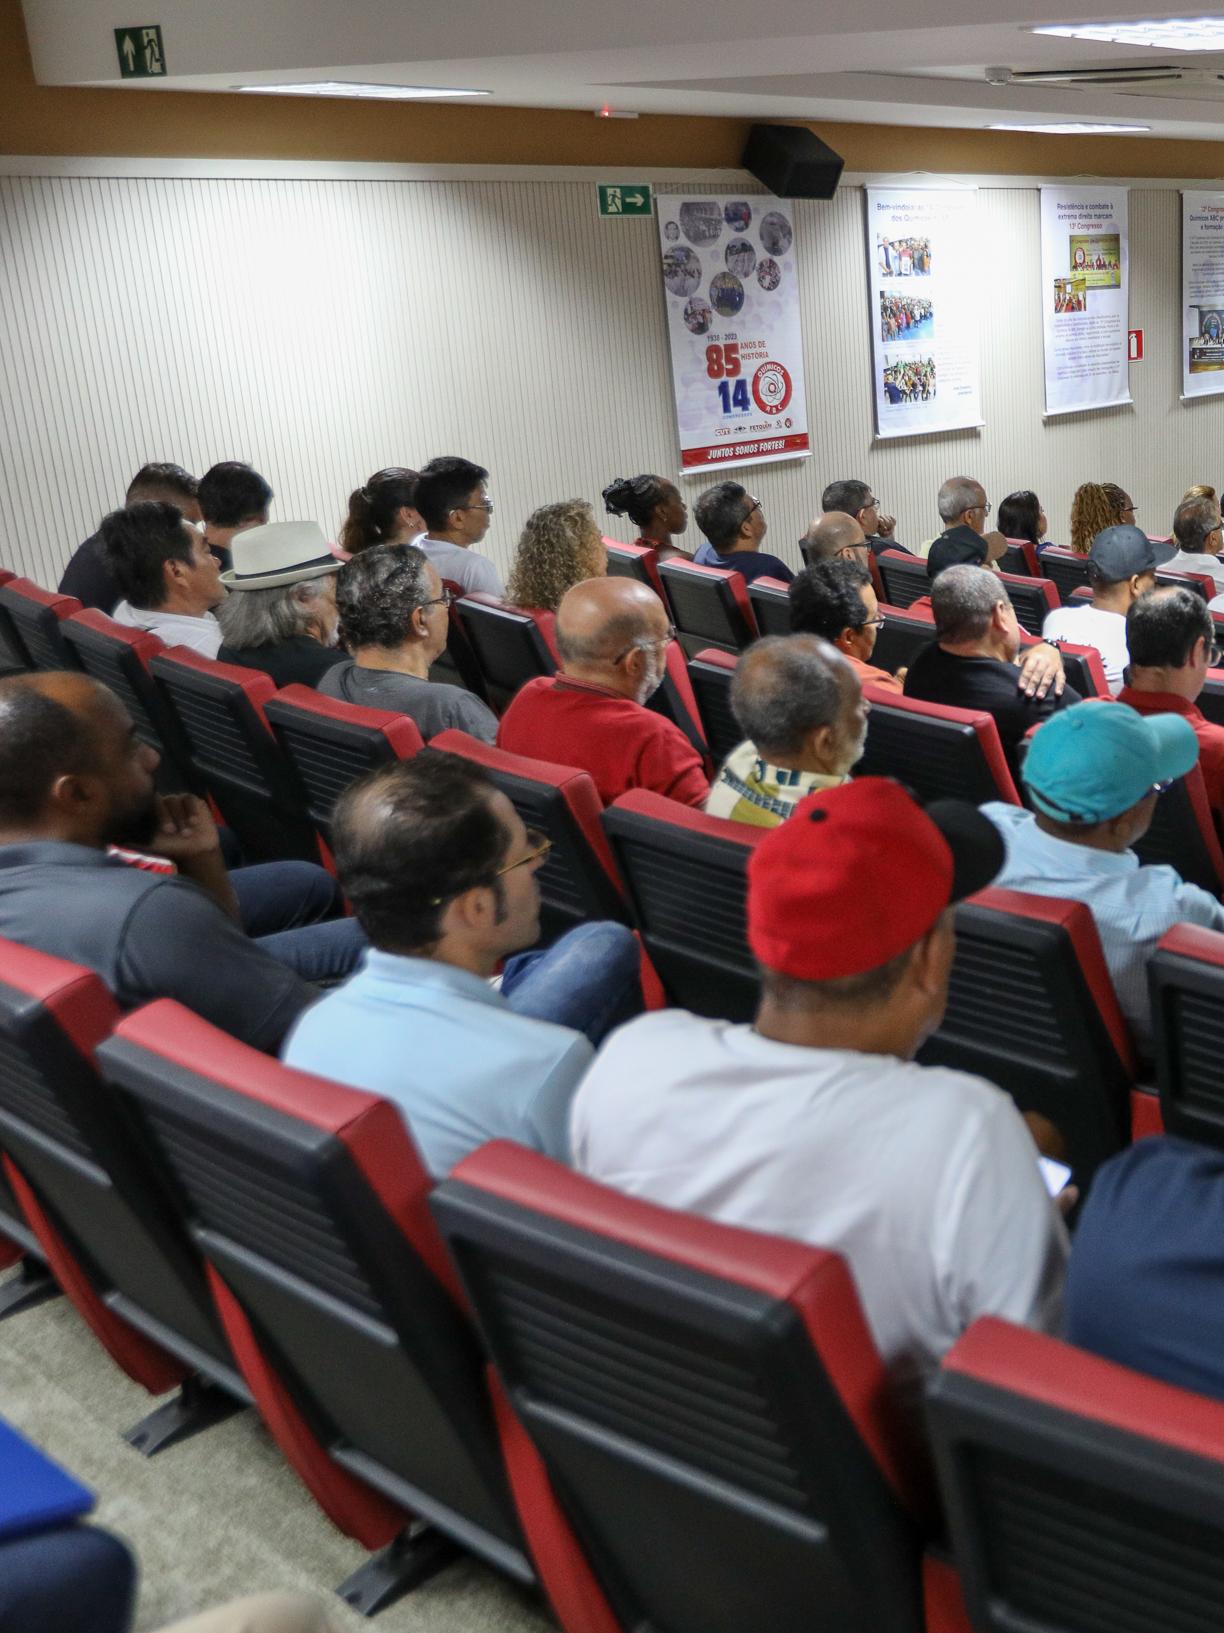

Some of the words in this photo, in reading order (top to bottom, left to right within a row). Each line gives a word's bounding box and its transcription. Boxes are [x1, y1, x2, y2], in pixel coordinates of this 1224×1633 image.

[891, 214, 902, 222] dos
[1189, 214, 1209, 222] Químicos
[1077, 223, 1103, 231] Congresso
[724, 333, 738, 341] 2023
[740, 341, 757, 349] ANOS
[741, 351, 769, 360] HISTÓRIA
[705, 342, 742, 379] 85
[757, 363, 785, 378] QUÍMICOS
[717, 378, 751, 414] 14
[707, 447, 734, 460] JUNTOS
[735, 443, 758, 456] SOMOS
[759, 439, 786, 452] FORTES!
